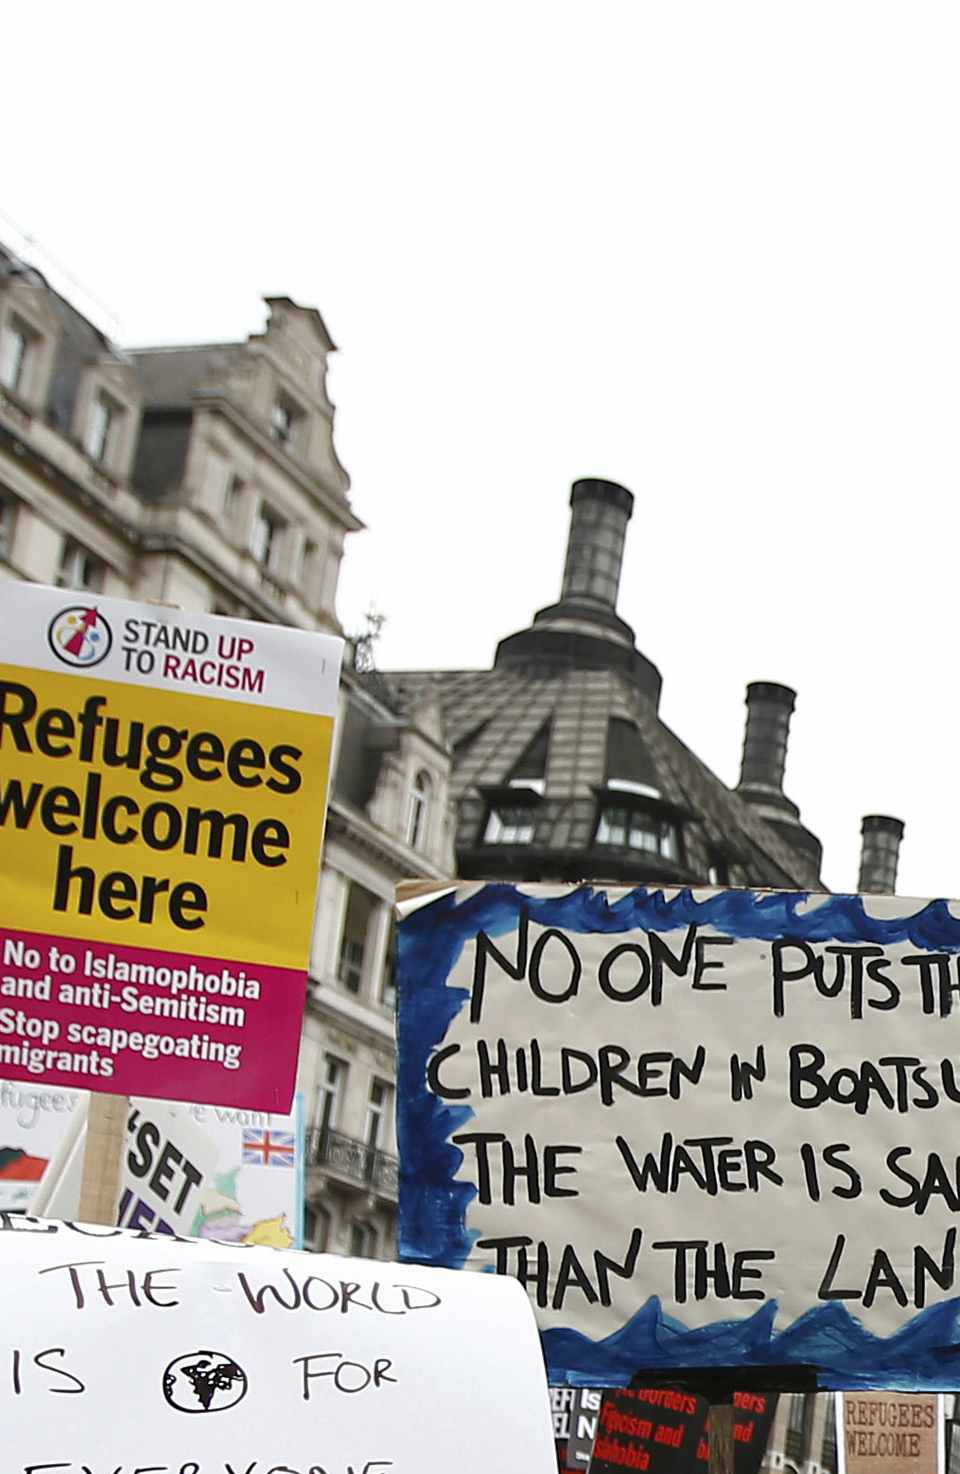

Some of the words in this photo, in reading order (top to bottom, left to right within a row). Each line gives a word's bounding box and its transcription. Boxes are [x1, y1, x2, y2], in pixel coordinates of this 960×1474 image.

[122, 620, 209, 655] STAND
[216, 636, 254, 663] UP
[121, 647, 155, 675] TO
[162, 656, 265, 694] RACISM
[52, 844, 208, 930] here
[2, 939, 41, 969] No
[48, 947, 76, 974] to
[83, 950, 261, 1000] Islamophobia
[468, 908, 582, 1023] NO
[598, 924, 734, 1006] ONE
[771, 938, 900, 1018] PUTS
[0, 974, 50, 1001] and
[58, 983, 246, 1027] anti-Semitism
[67, 1020, 242, 1071] scapegoating
[427, 1038, 706, 1107] CHILDREN
[730, 1045, 767, 1101] IN
[789, 1044, 939, 1115] BOATS
[452, 1133, 582, 1205] THE
[616, 1132, 783, 1196] WATER
[801, 1143, 862, 1200] IS
[40, 1262, 180, 1309] THE
[236, 1271, 442, 1314] WORLD
[476, 1227, 642, 1310] THAN
[652, 1240, 776, 1304] THE
[818, 1226, 958, 1308] LAN
[12, 1349, 85, 1396] IS
[293, 1354, 397, 1401] FOR
[846, 1400, 935, 1428] REFUGEES
[846, 1430, 921, 1457] WELCOME
